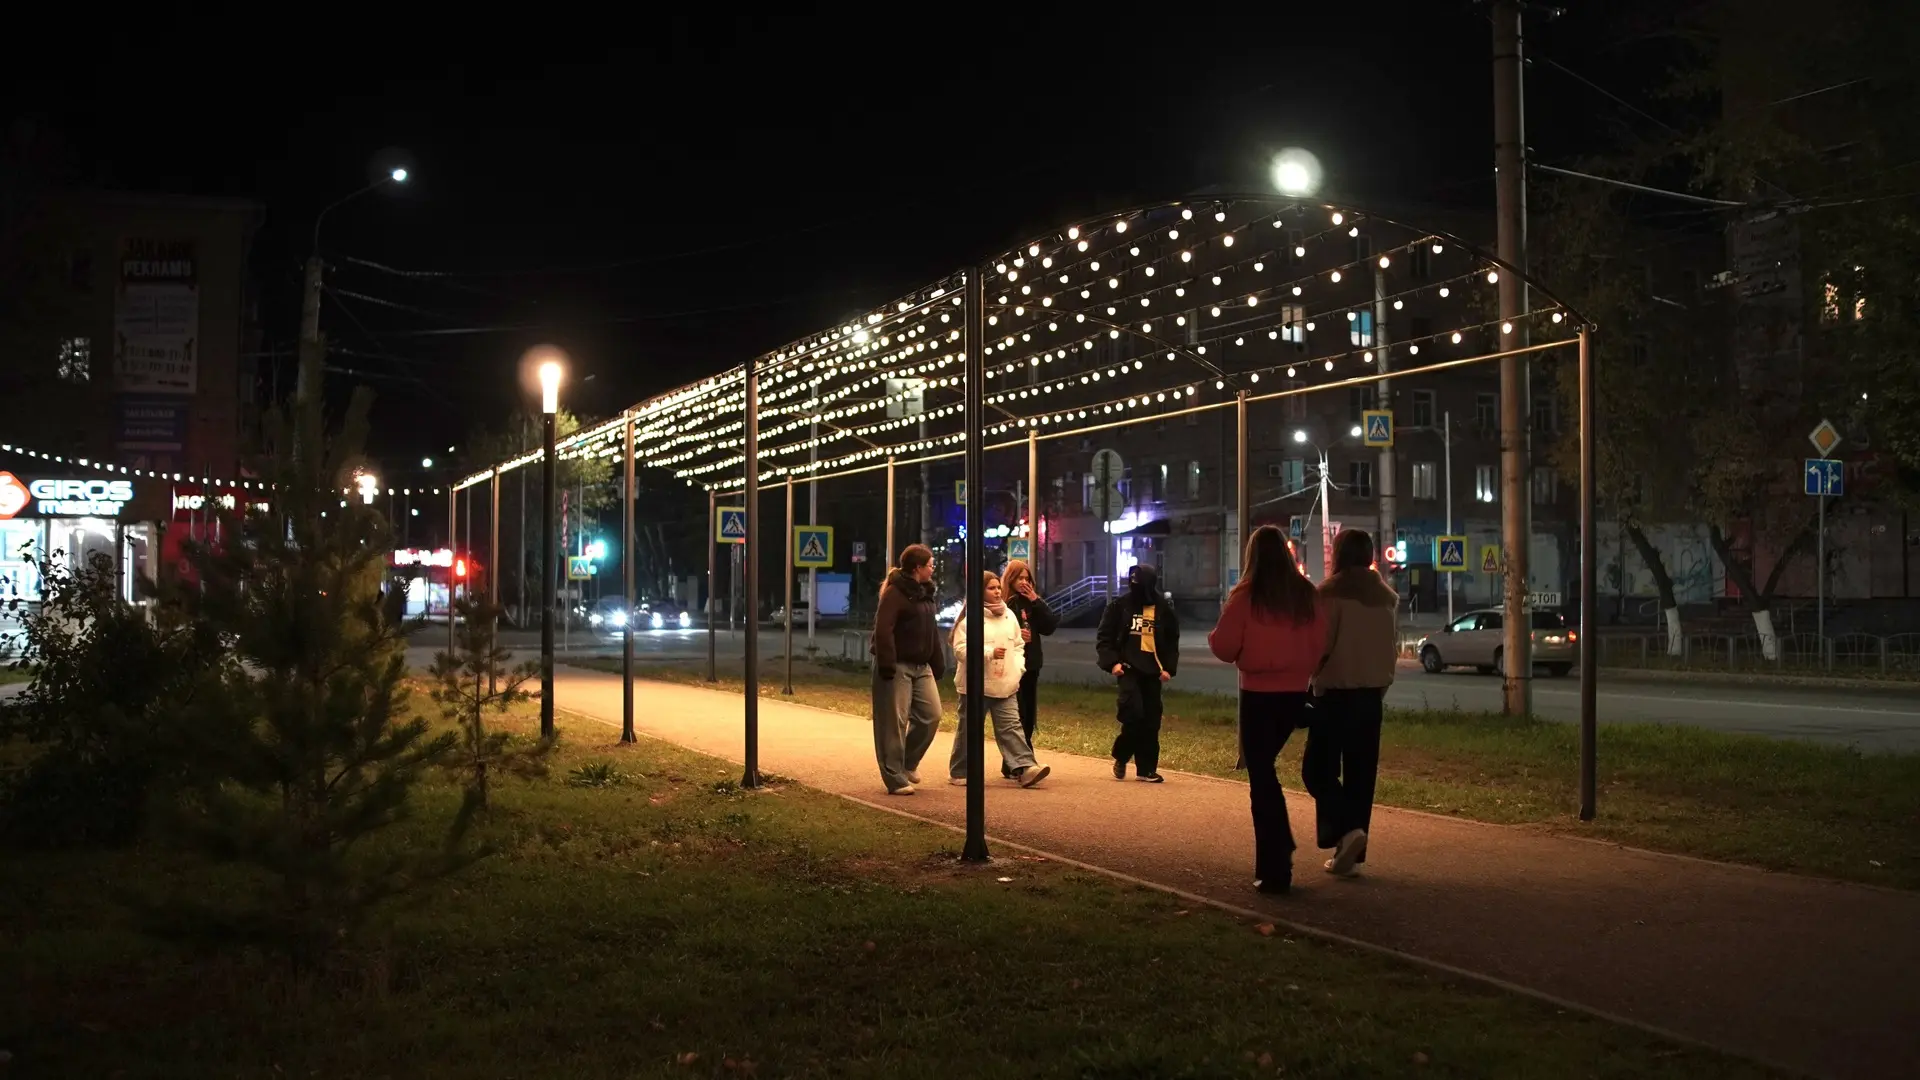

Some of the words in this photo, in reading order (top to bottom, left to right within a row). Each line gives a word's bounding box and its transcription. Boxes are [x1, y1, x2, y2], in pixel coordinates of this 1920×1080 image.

[123, 260, 192, 277] РЕКЛАМУ
[30, 479, 133, 501] GIROS
[38, 500, 124, 515] master
